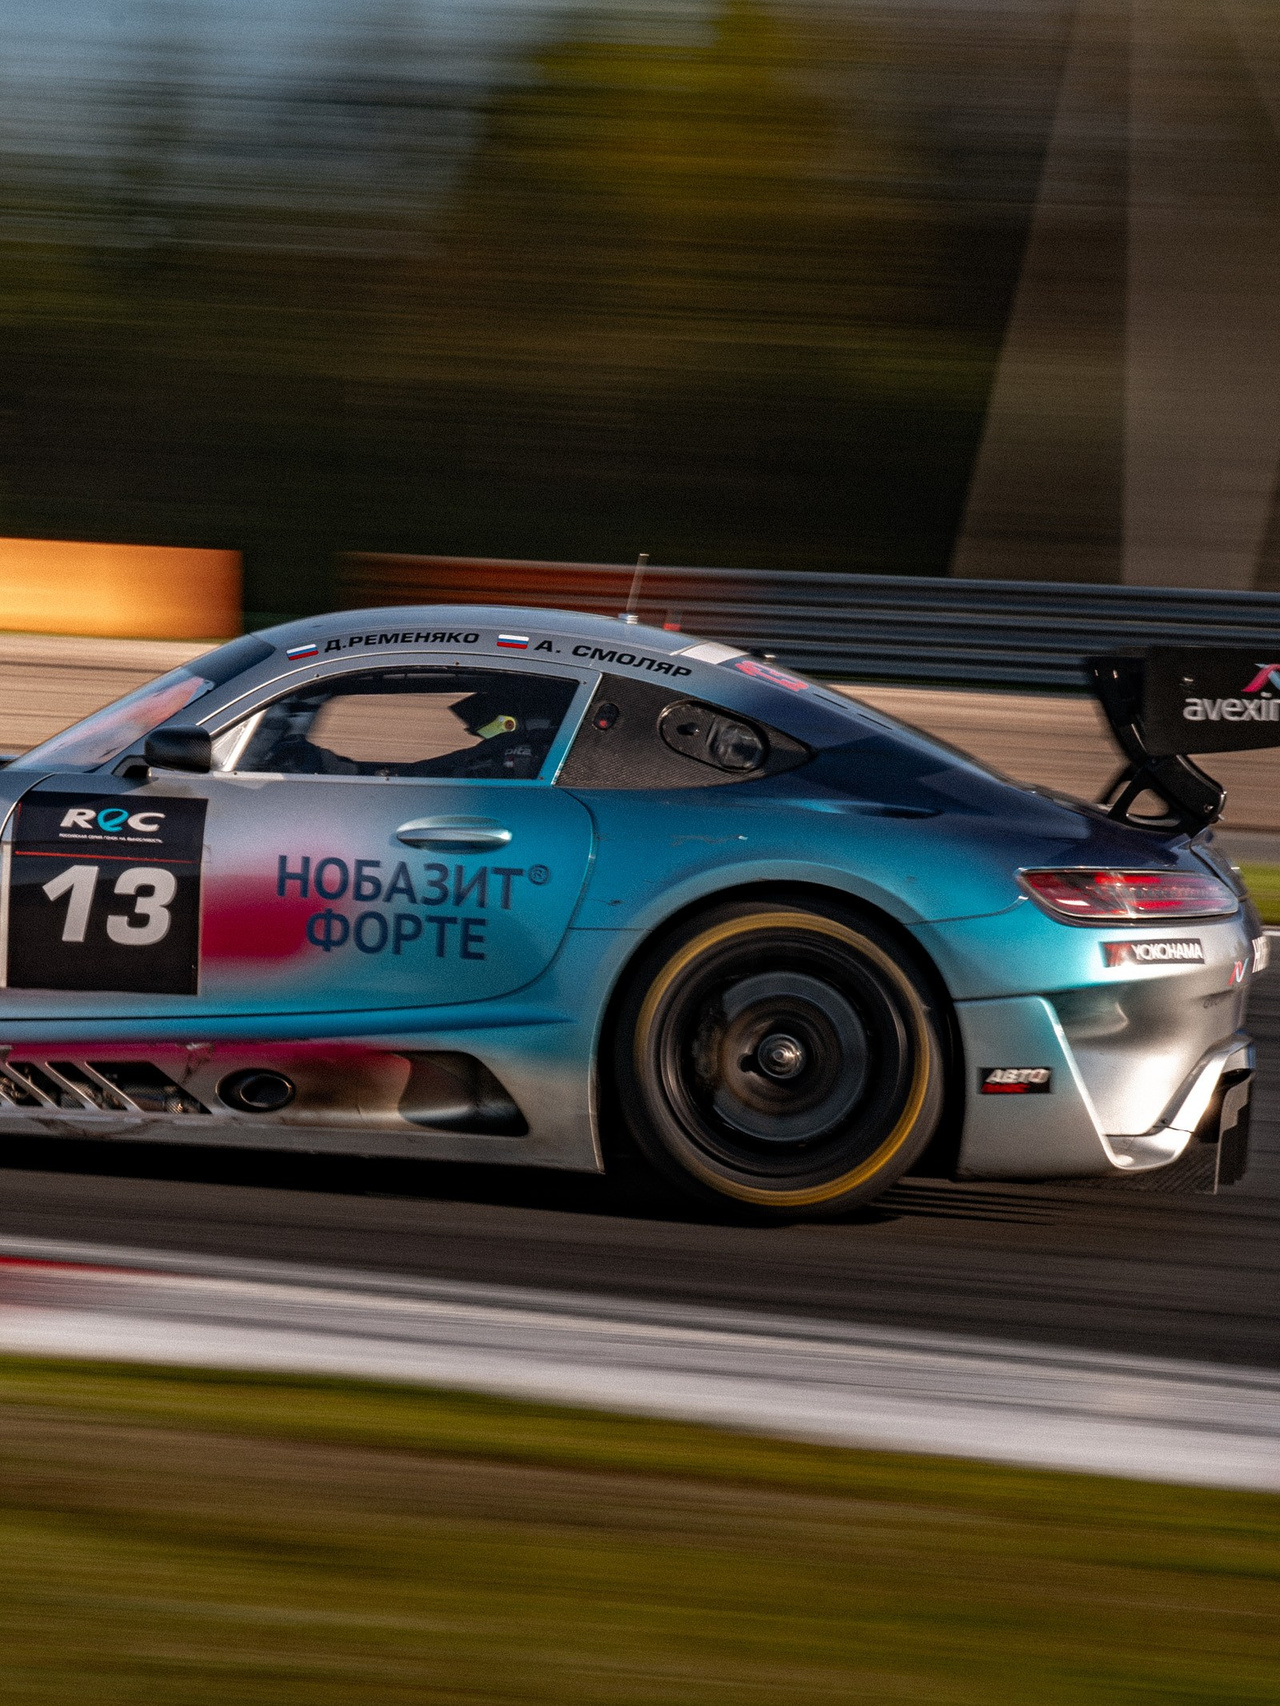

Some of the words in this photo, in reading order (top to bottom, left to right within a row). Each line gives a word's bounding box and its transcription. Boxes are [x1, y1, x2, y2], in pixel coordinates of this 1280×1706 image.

[534, 640, 561, 653] А.
[572, 645, 692, 677] СМОЛЯР
[42, 864, 177, 946] 13
[305, 908, 488, 960] ФОРТЕ
[1131, 942, 1203, 961] YOKOHAMA
